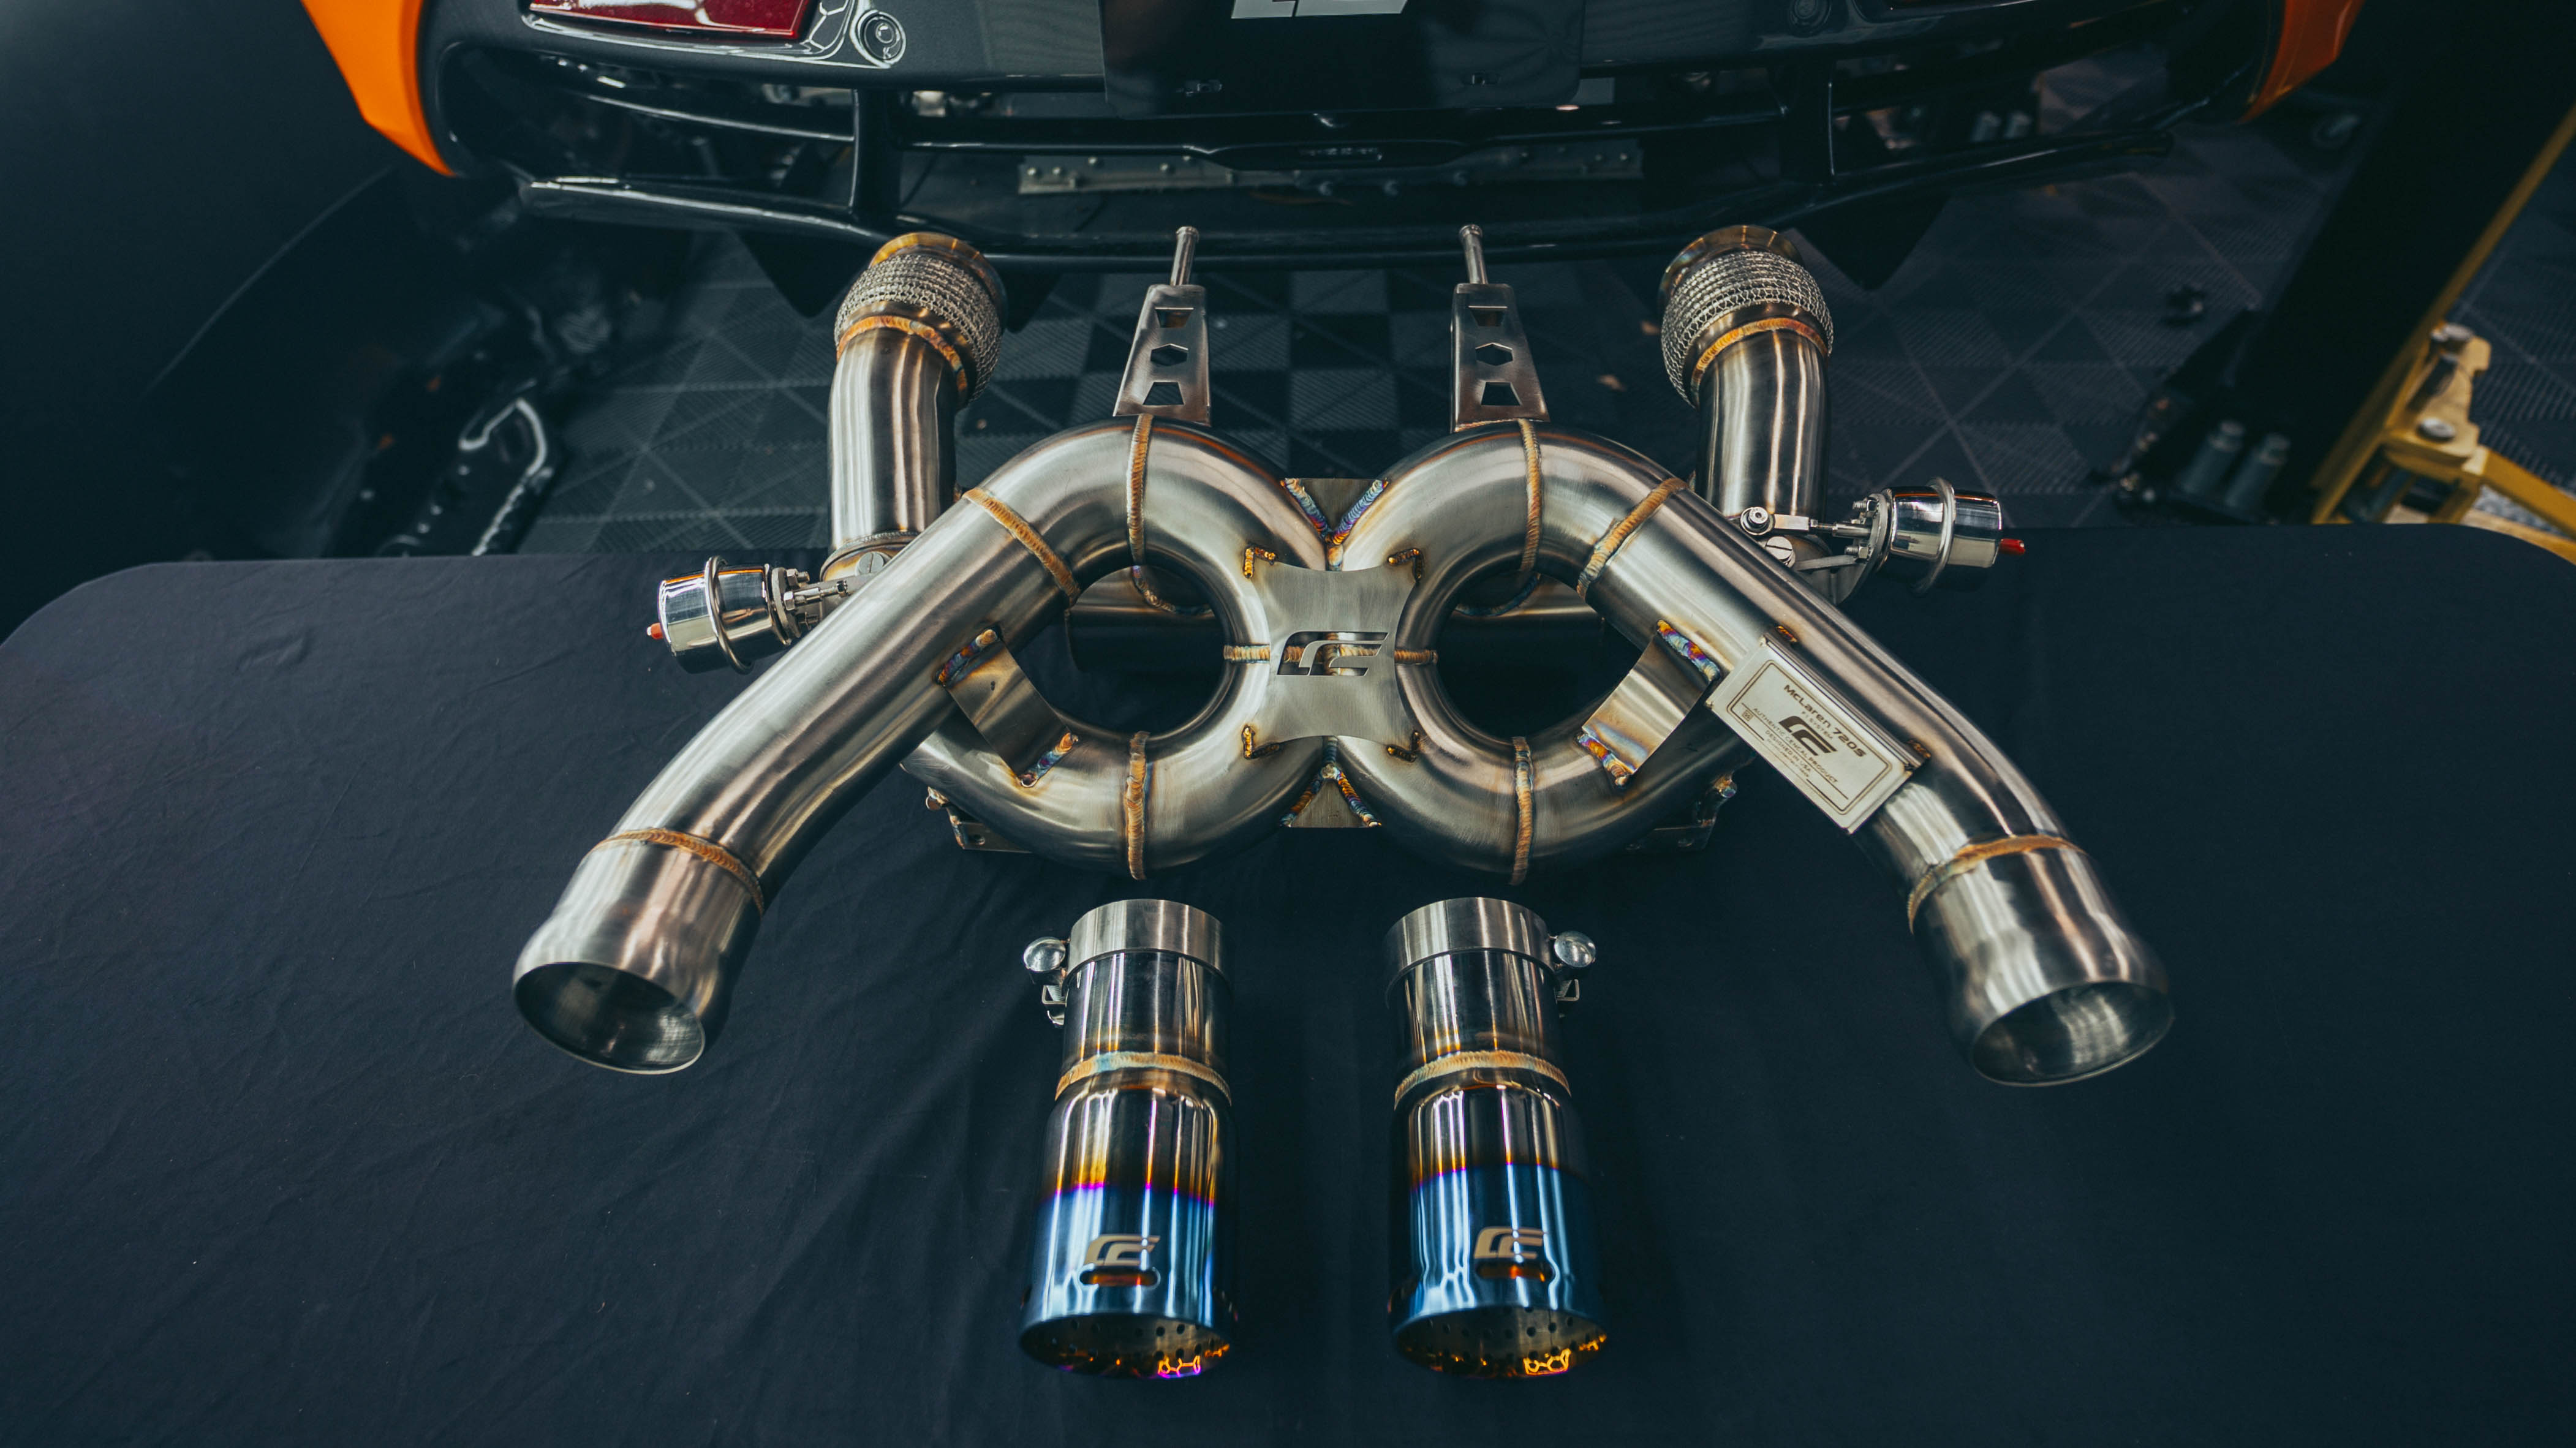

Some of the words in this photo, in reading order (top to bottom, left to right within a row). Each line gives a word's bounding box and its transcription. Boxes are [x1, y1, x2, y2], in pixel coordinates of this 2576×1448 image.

[1753, 706, 1785, 736] AUTHENTIC
[1807, 756, 1838, 784] PRODUCT
[1764, 729, 1793, 756] DESIGNED
[1799, 760, 1811, 772] USA
[1783, 683, 1832, 729] McLaren
[1830, 726, 1867, 758] 720S
